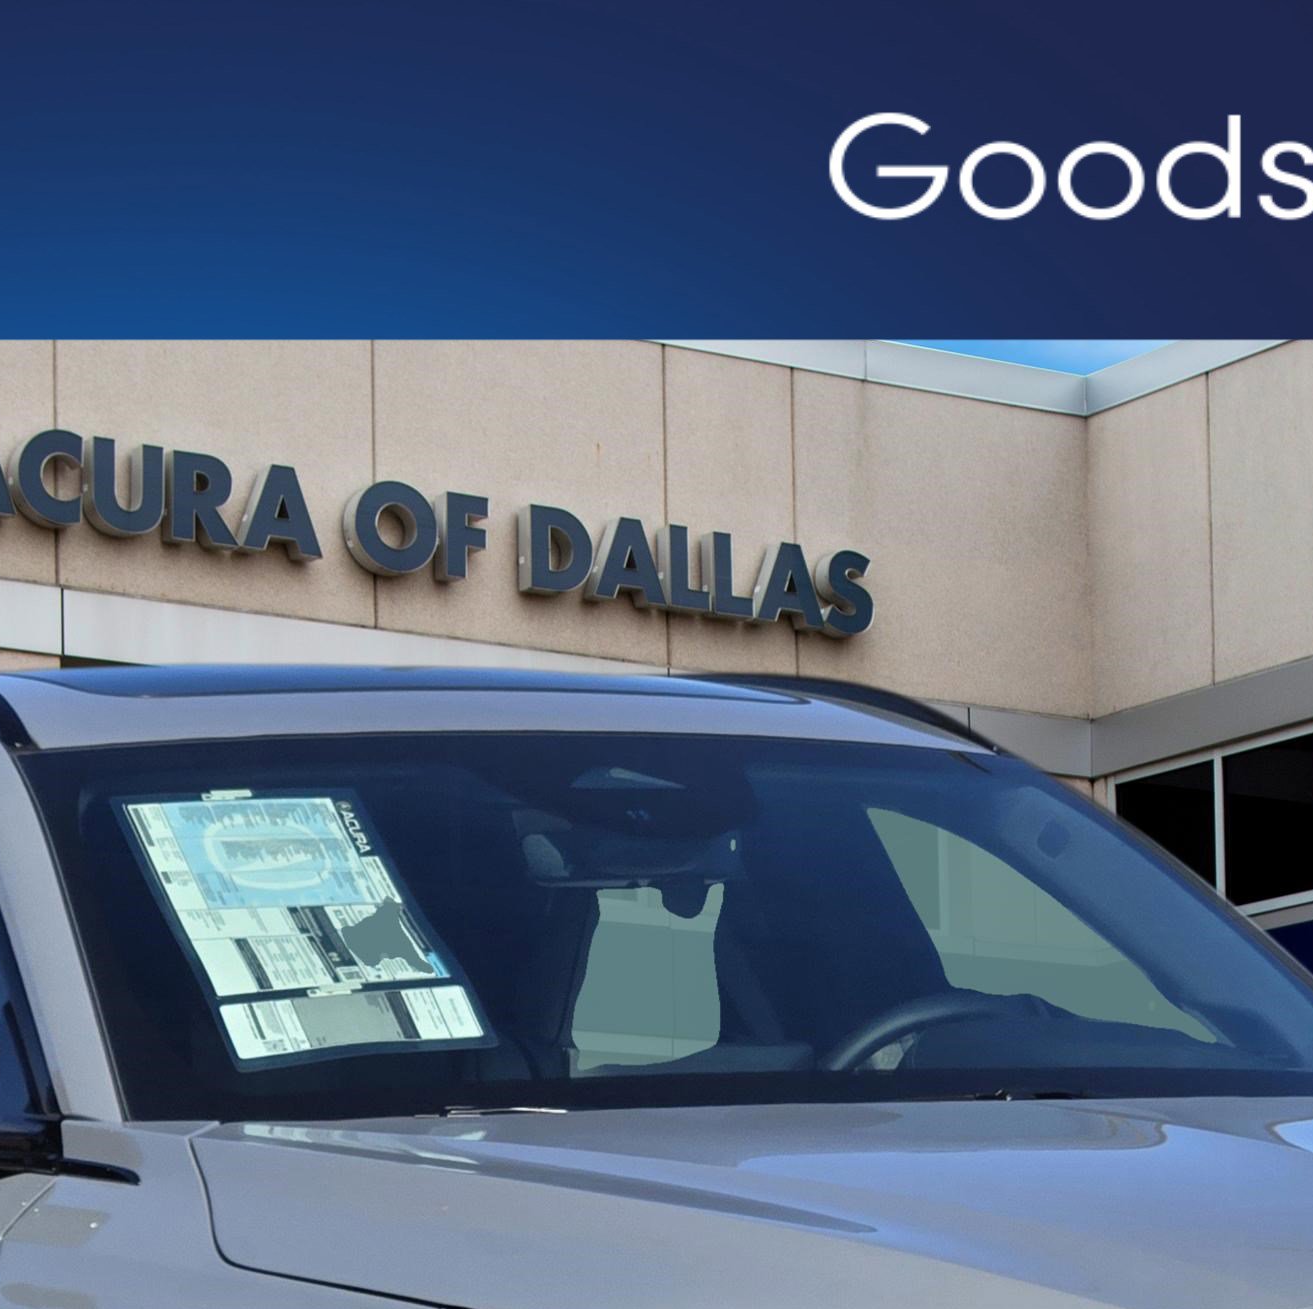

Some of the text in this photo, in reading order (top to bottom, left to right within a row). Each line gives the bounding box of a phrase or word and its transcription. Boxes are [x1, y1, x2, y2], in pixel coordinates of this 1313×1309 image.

[343, 480, 489, 583] OF
[518, 503, 874, 638] DALLAS
[341, 810, 371, 853] ACURA
